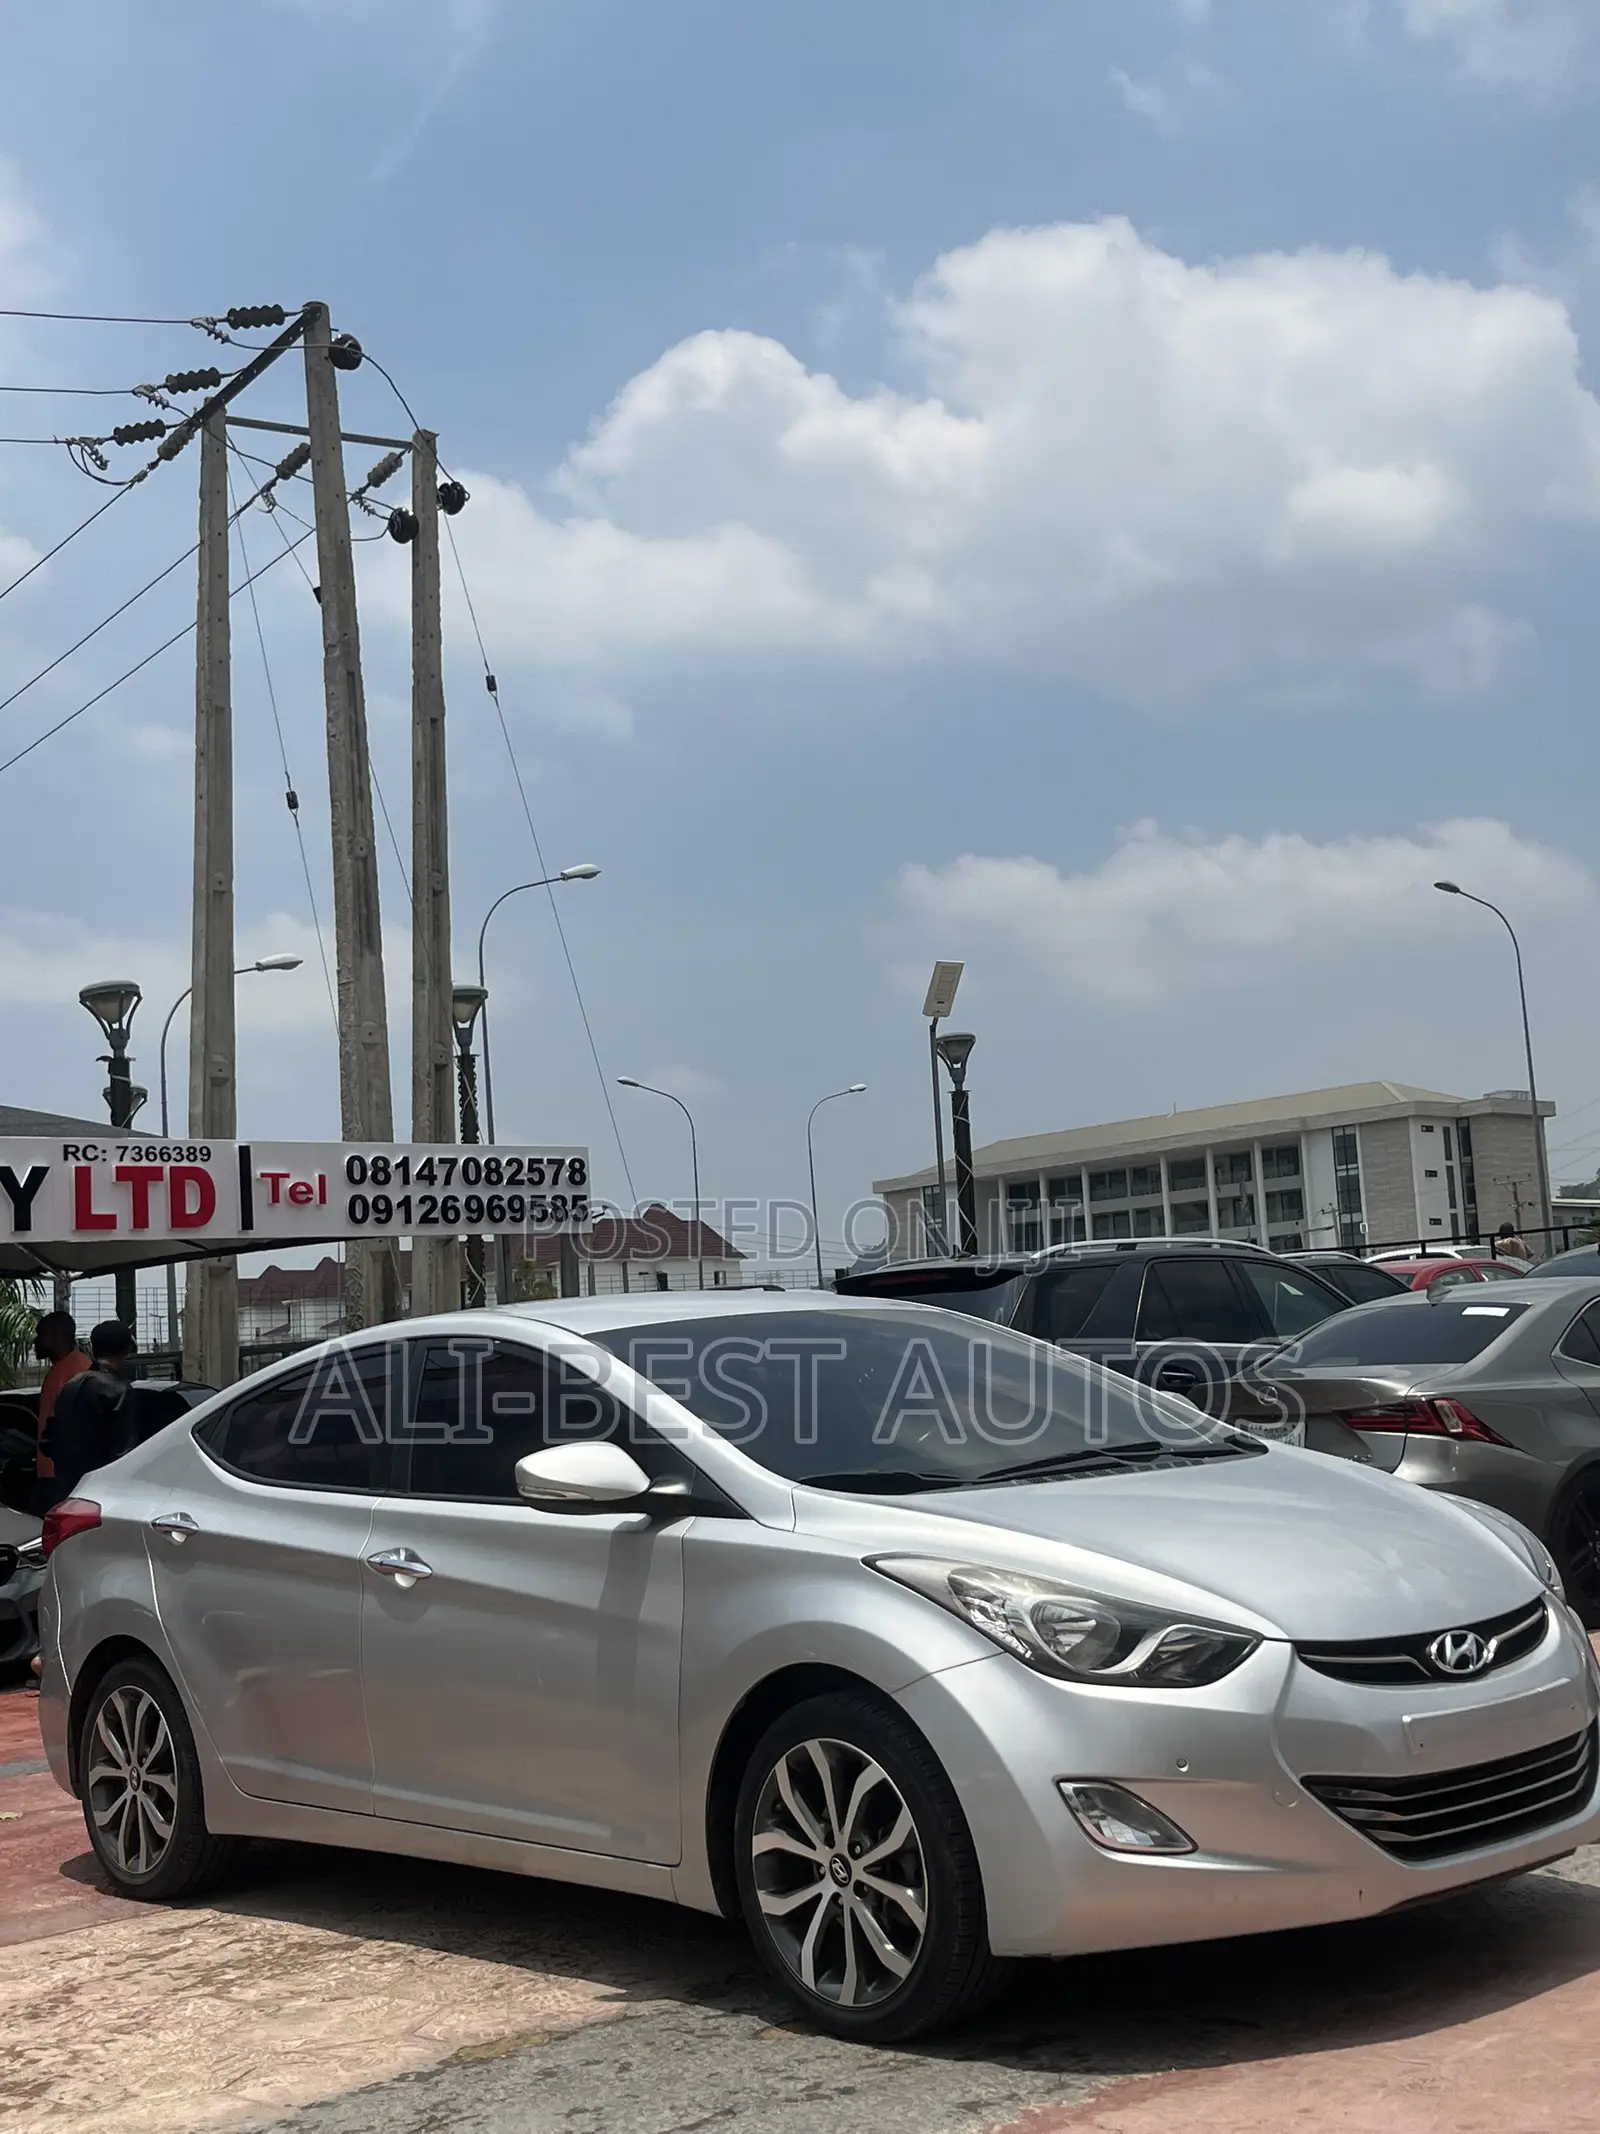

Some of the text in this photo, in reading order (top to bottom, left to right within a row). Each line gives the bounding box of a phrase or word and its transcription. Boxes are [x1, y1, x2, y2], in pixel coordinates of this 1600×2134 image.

[63, 1144, 212, 1162] RC: 7366389
[345, 1155, 586, 1186] 08147082578
[74, 1165, 216, 1230] LTD
[260, 1172, 327, 1205] Tel
[348, 1194, 588, 1225] 09126969585
